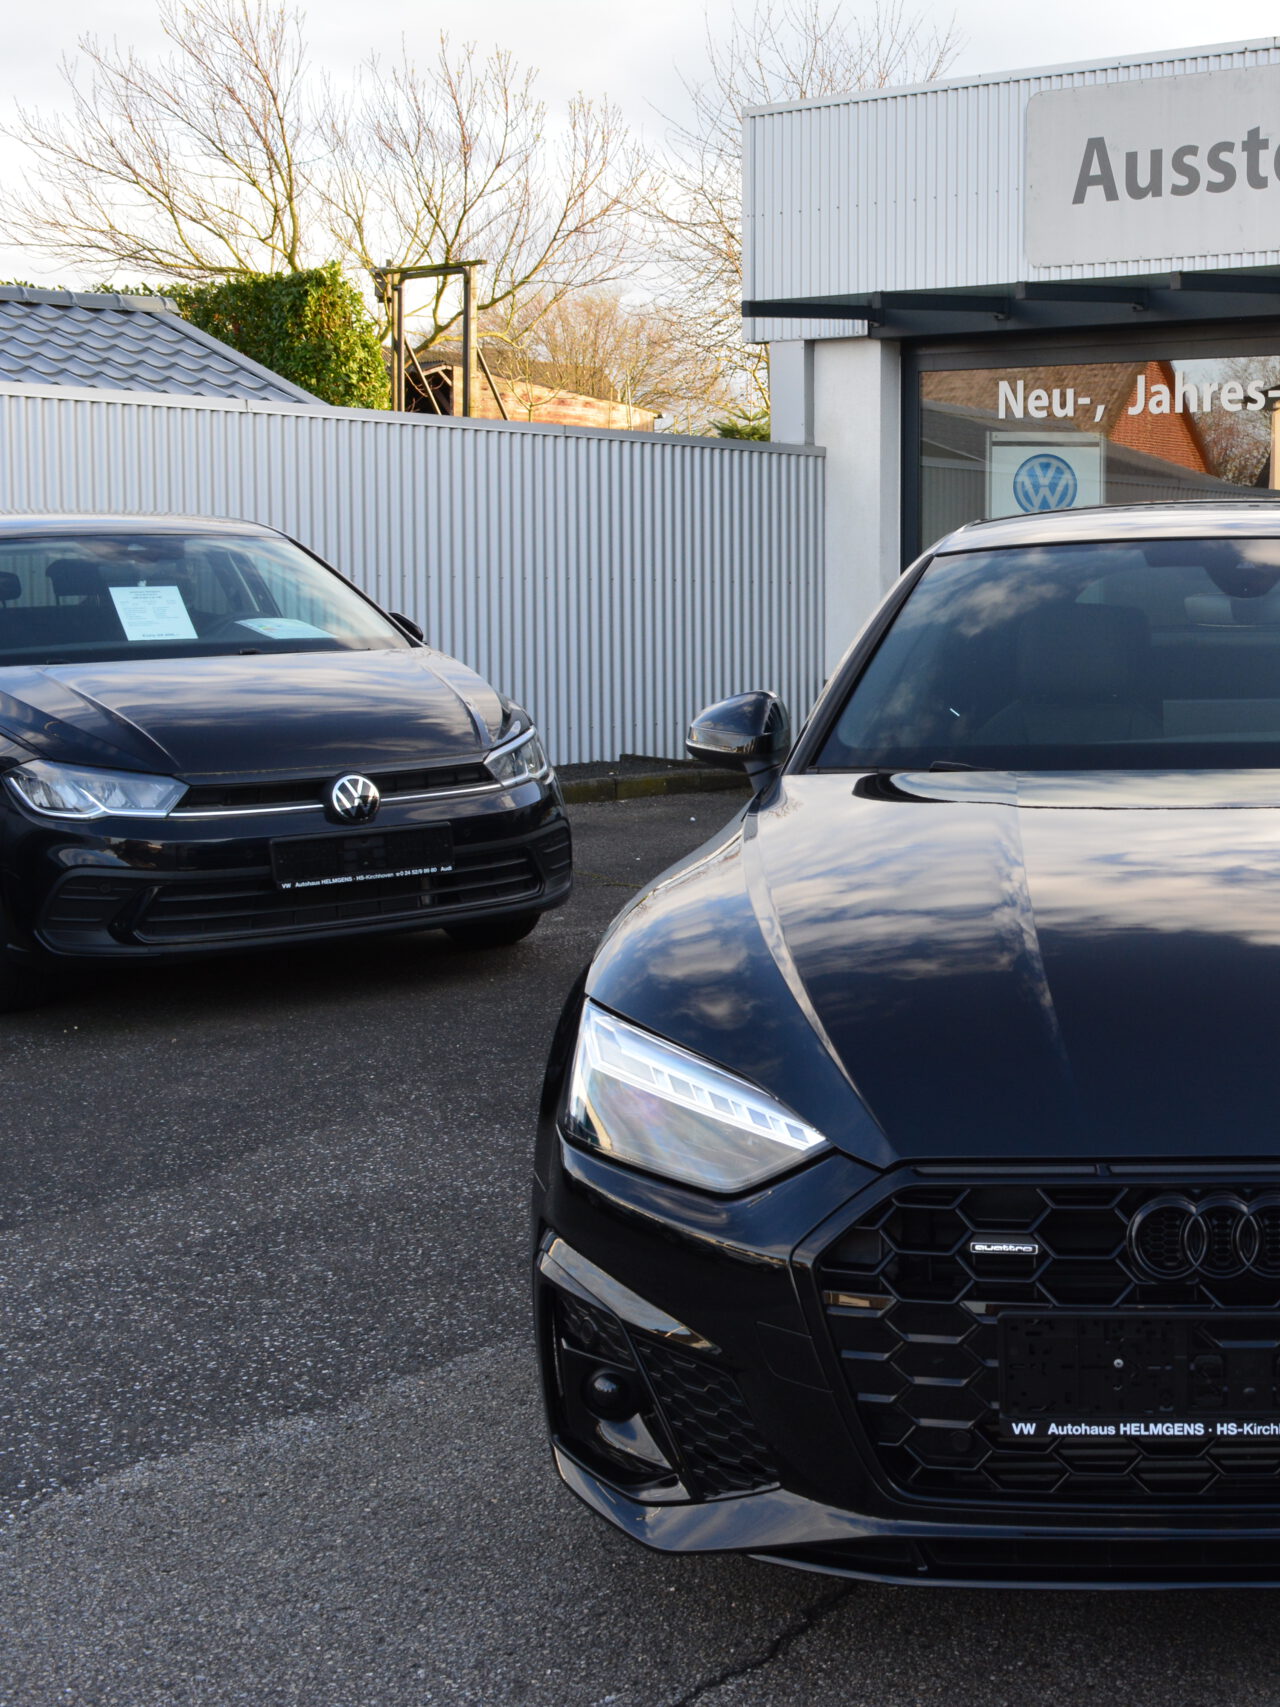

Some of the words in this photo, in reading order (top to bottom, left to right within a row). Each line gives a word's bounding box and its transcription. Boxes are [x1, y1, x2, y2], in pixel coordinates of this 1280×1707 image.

[998, 379, 1106, 422] Neu-,
[295, 880, 321, 888] Autohaus
[974, 1244, 1033, 1252] quattro
[1011, 1422, 1036, 1435] VW
[1048, 1422, 1116, 1436] Autohaus
[1119, 1422, 1205, 1436] HELMGENS
